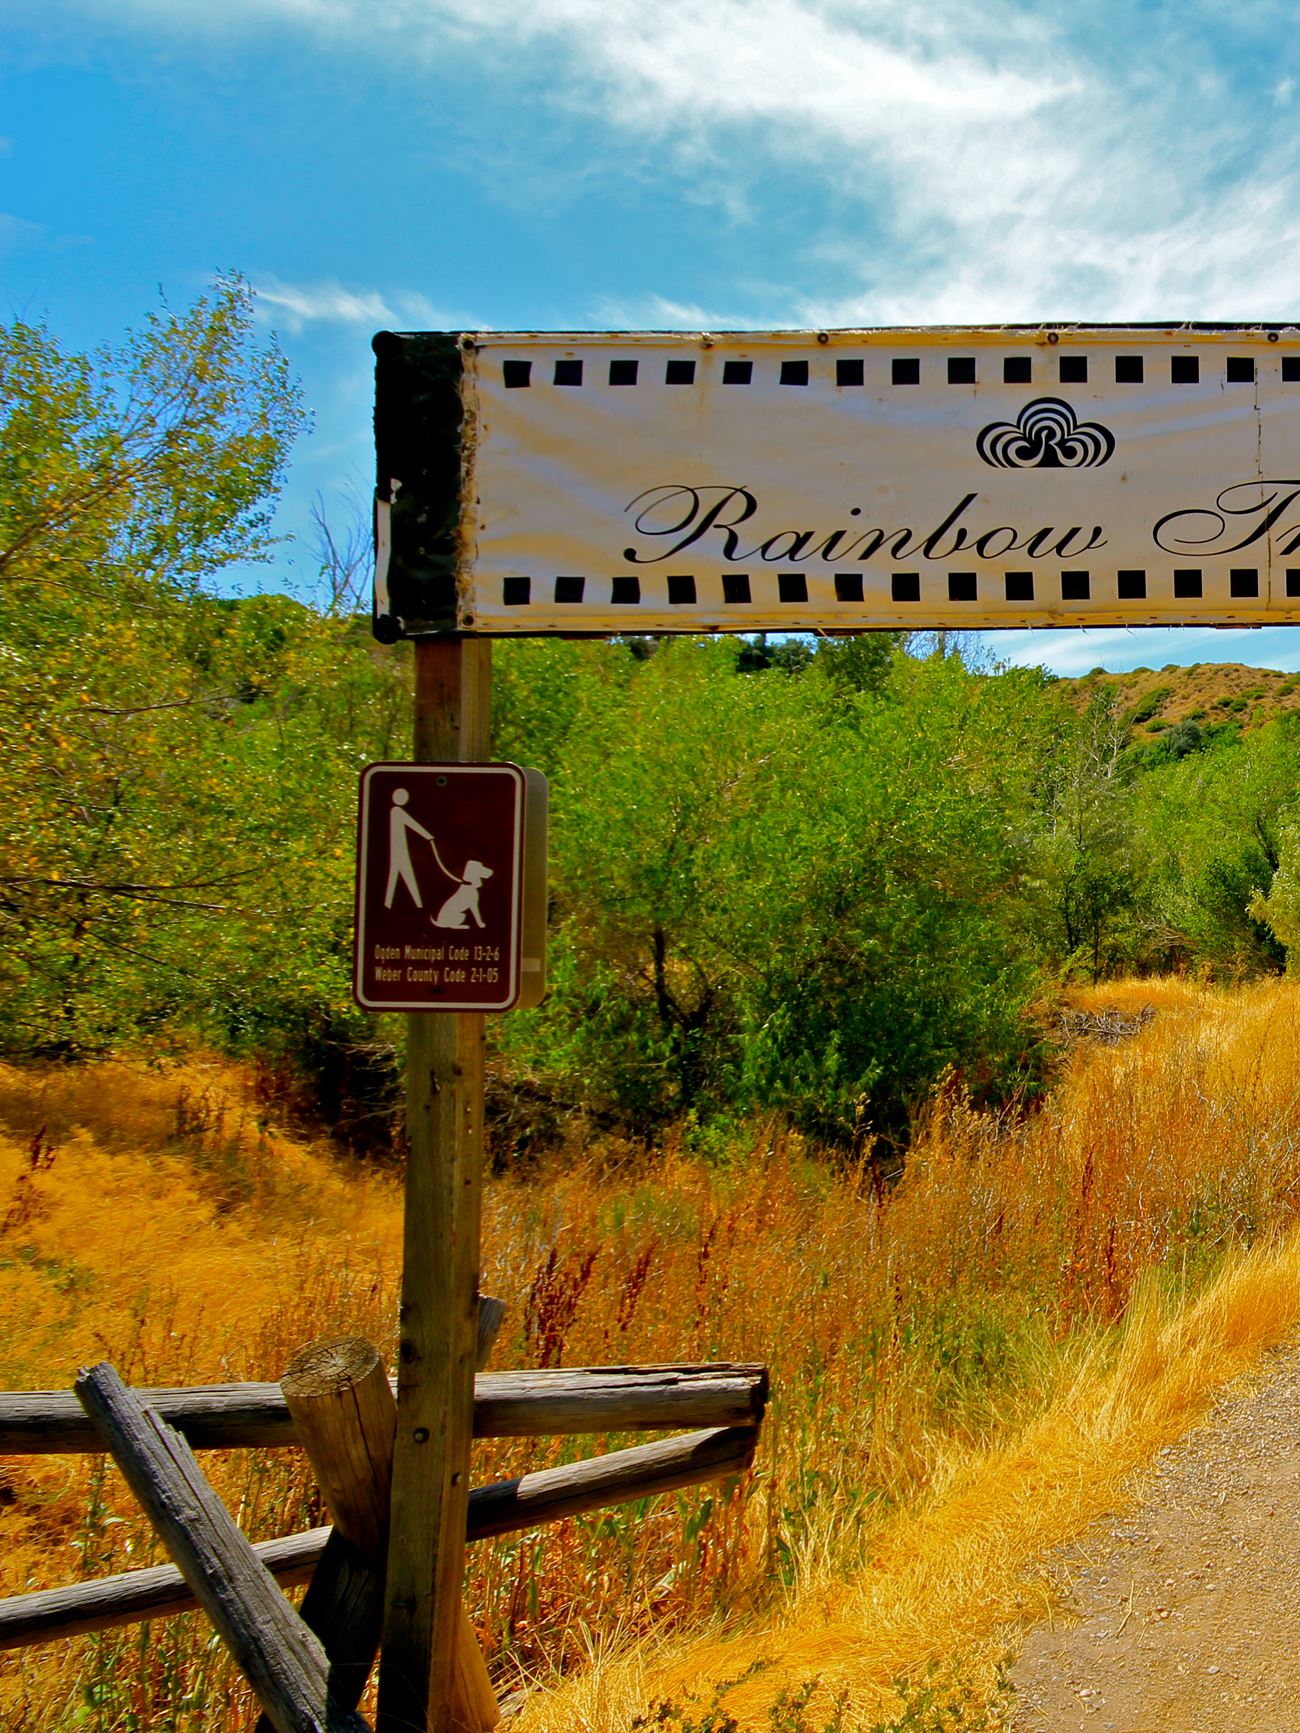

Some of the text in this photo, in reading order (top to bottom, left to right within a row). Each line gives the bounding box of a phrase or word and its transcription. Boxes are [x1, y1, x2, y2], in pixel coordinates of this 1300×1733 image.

[623, 484, 1109, 564] Rainbow
[374, 944, 500, 964] Ogden Municipal Code 13-2-6
[374, 966, 499, 985] Weber County Code 2-1-05
